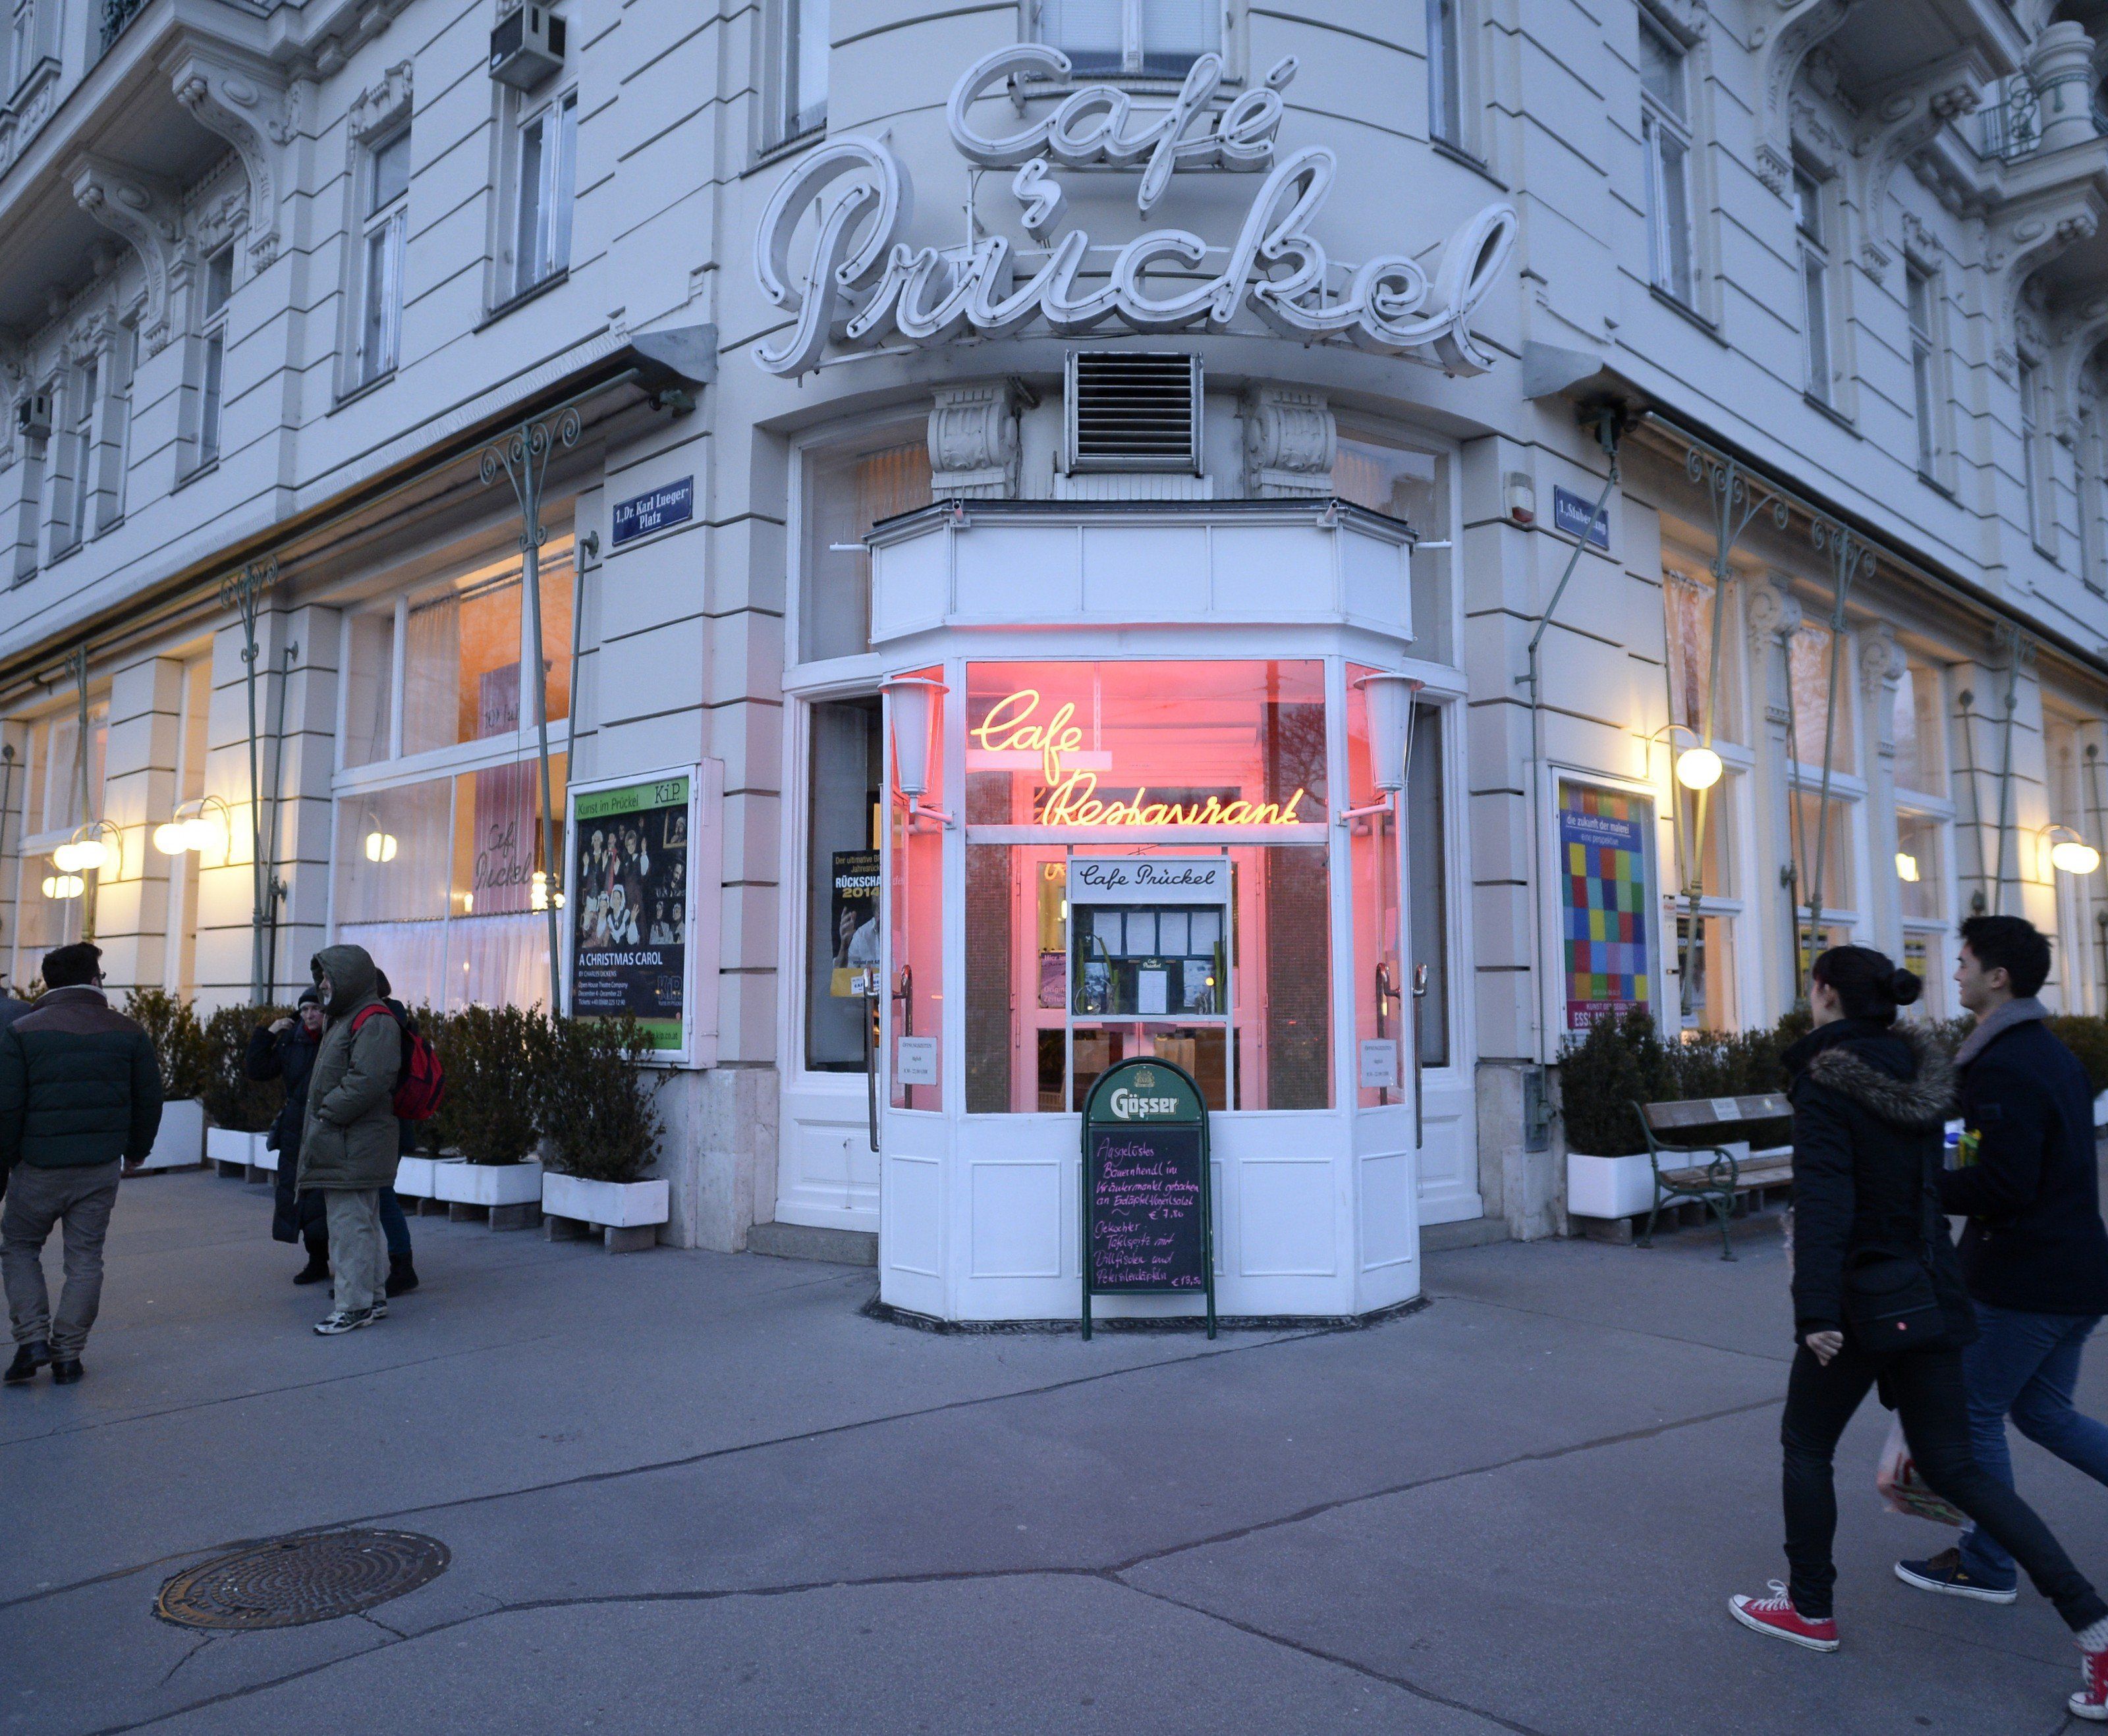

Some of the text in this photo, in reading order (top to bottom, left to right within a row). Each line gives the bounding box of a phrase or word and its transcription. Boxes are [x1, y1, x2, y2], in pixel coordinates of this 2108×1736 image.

[947, 43, 1299, 213] Café
[750, 136, 1520, 379] Prückel
[636, 495, 653, 516] Karl
[639, 510, 661, 529] Platz
[578, 794, 638, 815] Kunst im Prückel
[1043, 769, 1304, 826] Restaurant
[1135, 864, 1216, 885] Prückel
[842, 886, 879, 898] 2014
[579, 952, 663, 966] A CHRISTMAS CAROL
[1110, 1088, 1179, 1120] Gösser
